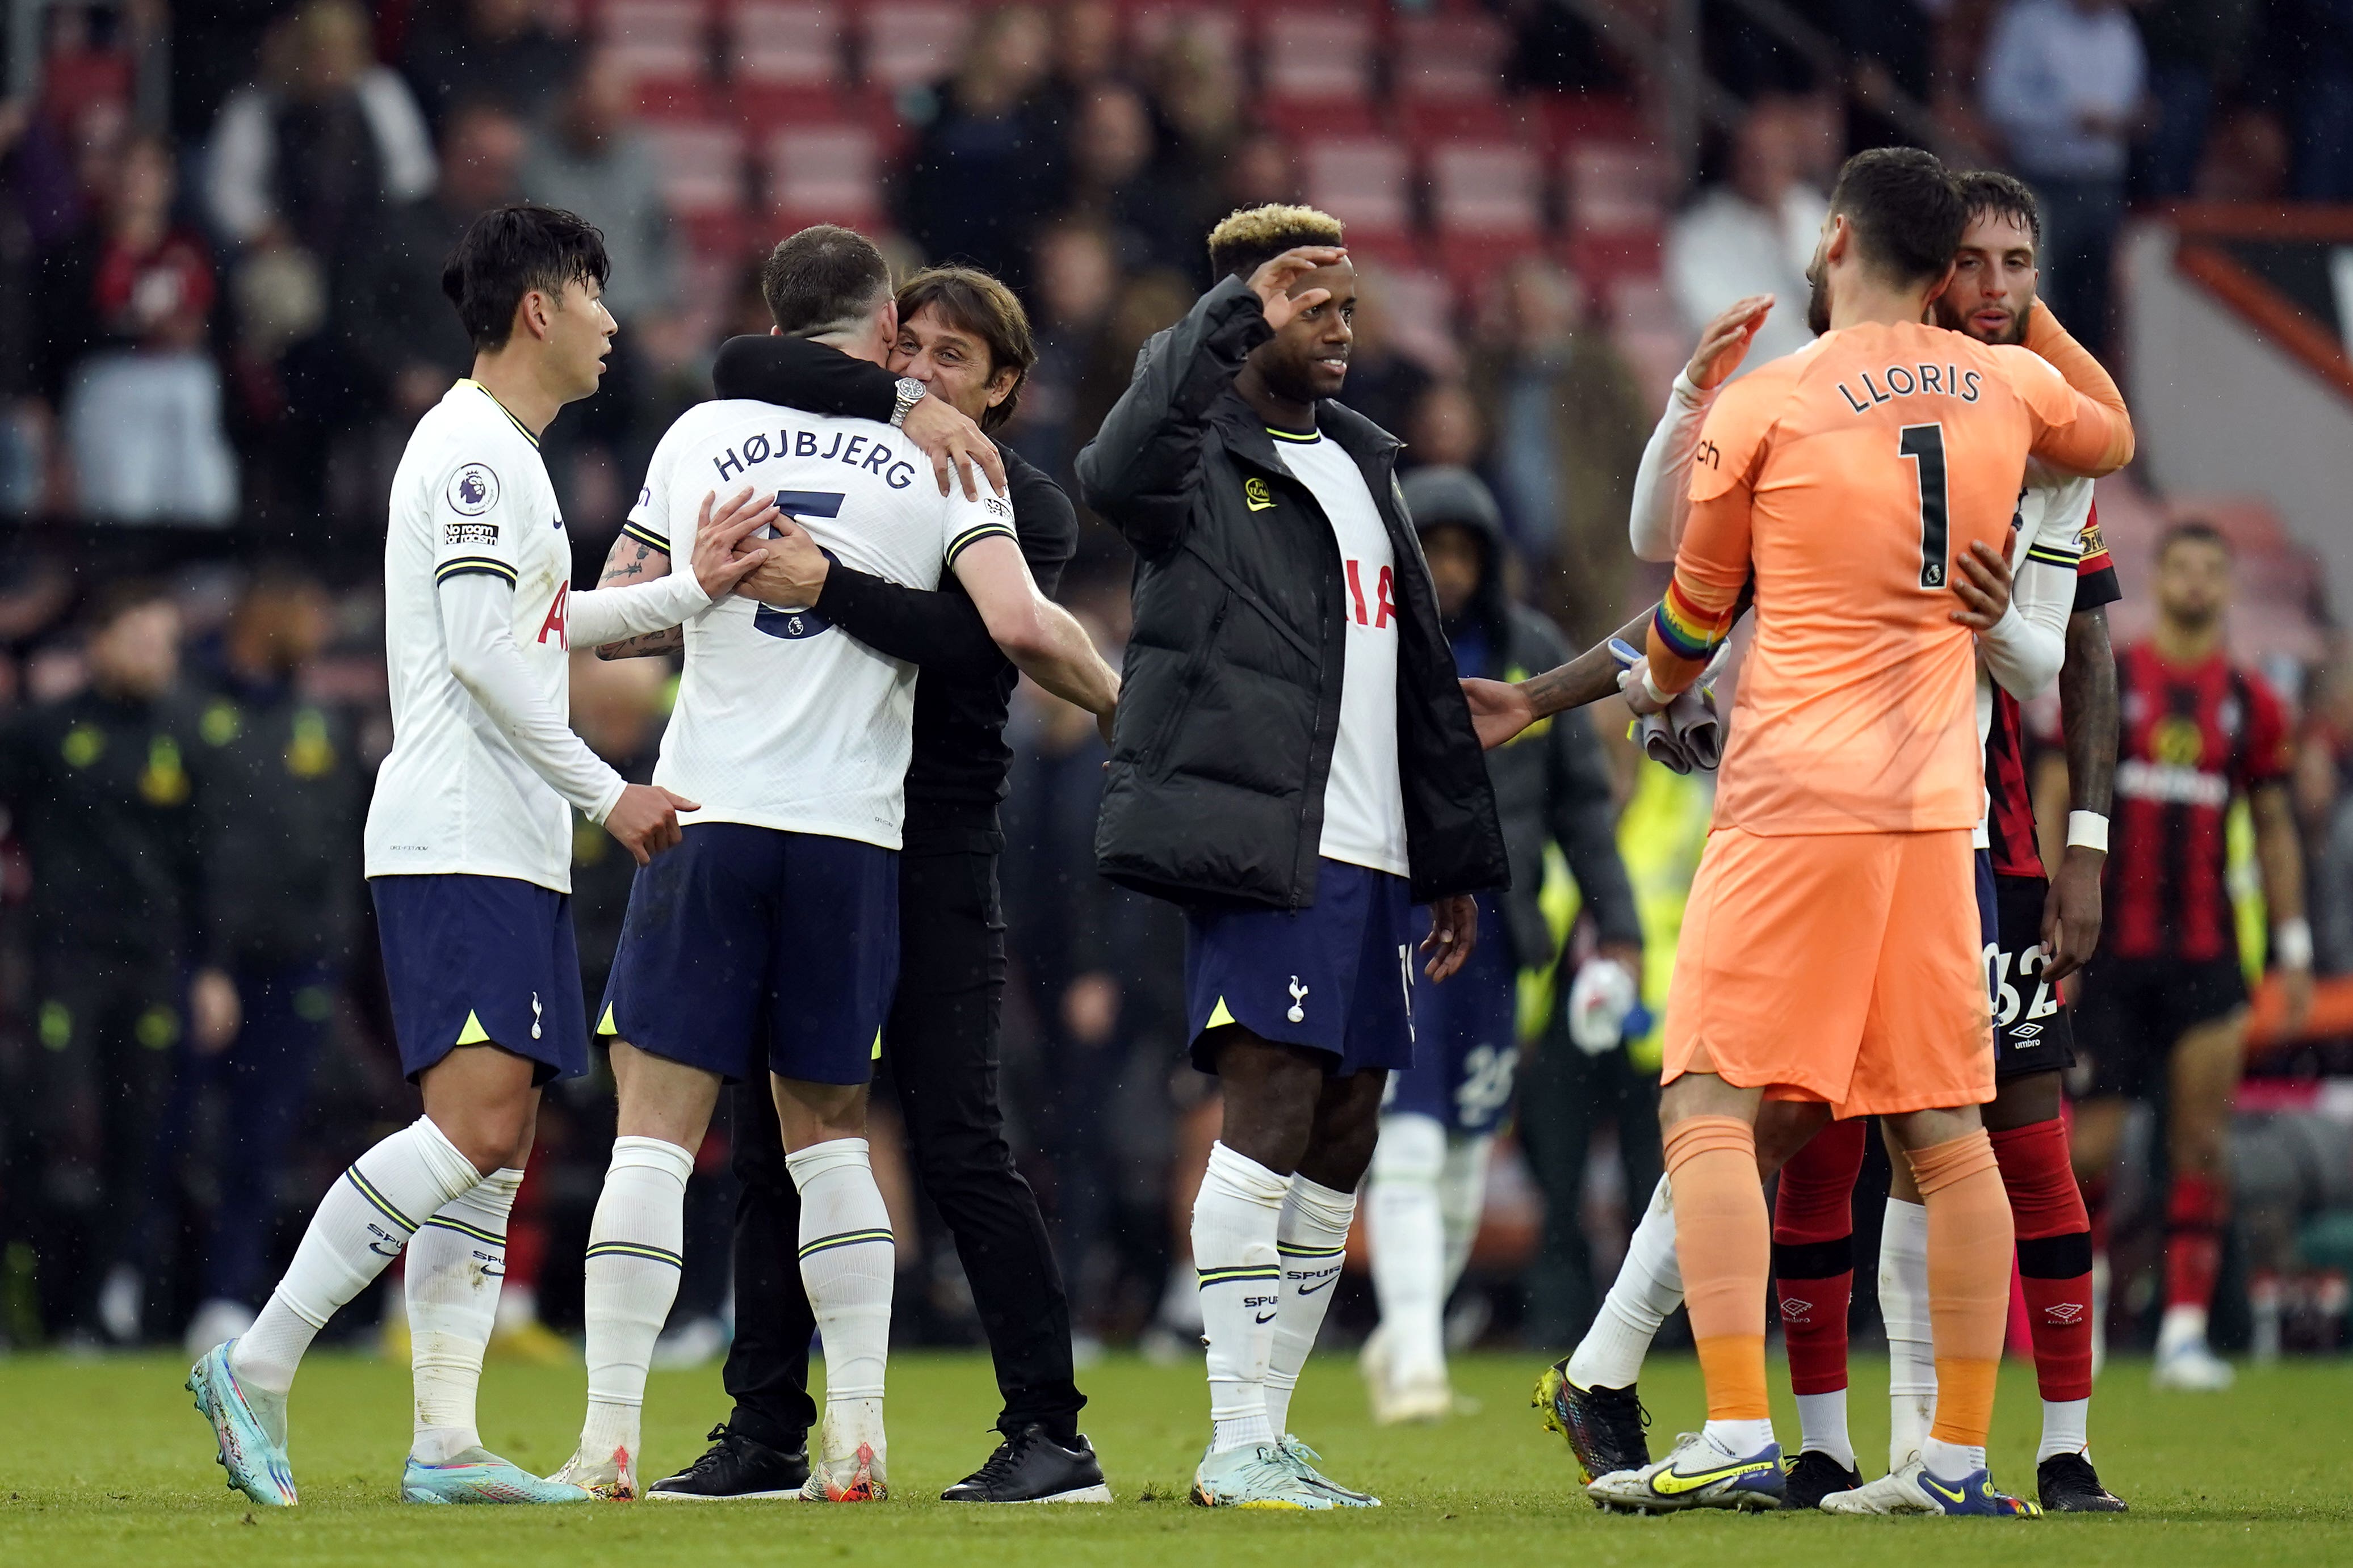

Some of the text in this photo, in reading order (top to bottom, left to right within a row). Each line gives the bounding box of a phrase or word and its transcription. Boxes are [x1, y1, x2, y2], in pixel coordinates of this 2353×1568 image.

[1838, 363, 1982, 415] LLORIS
[712, 429, 915, 489] HØJBJERG
[444, 524, 493, 536] No room
[1898, 422, 1952, 590] 1
[445, 533, 497, 546] for racism
[538, 579, 569, 652] A
[1345, 560, 1396, 629] IA
[2015, 1039, 2041, 1049] umbro
[367, 1222, 404, 1248] SPU
